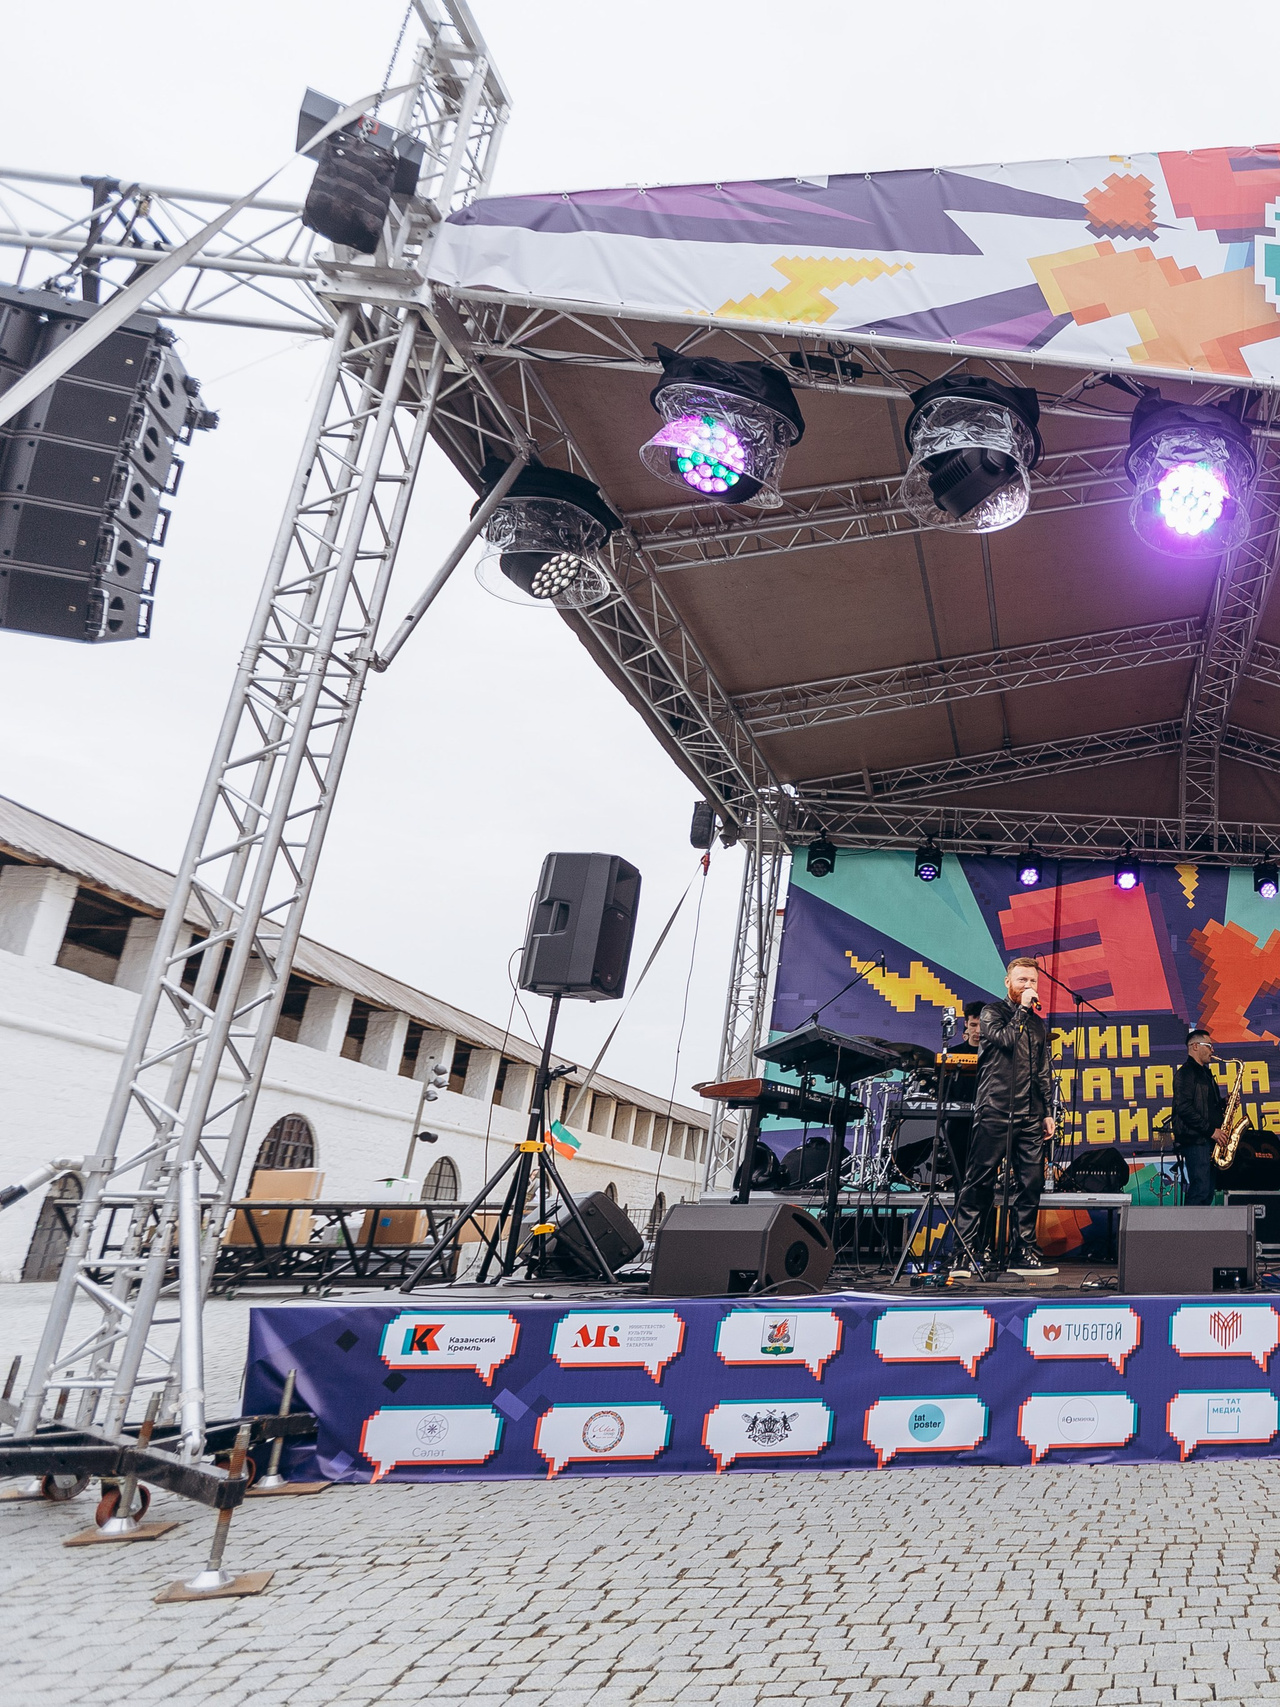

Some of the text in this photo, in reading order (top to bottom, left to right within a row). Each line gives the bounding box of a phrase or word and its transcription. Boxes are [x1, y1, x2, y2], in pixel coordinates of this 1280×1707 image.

[1051, 1025, 1151, 1060] МИН
[1052, 1060, 1271, 1103] ТАТАЧА
[449, 1336, 496, 1344] Казанский
[913, 1421, 942, 1430] poster
[412, 1447, 446, 1458] Сәләт
